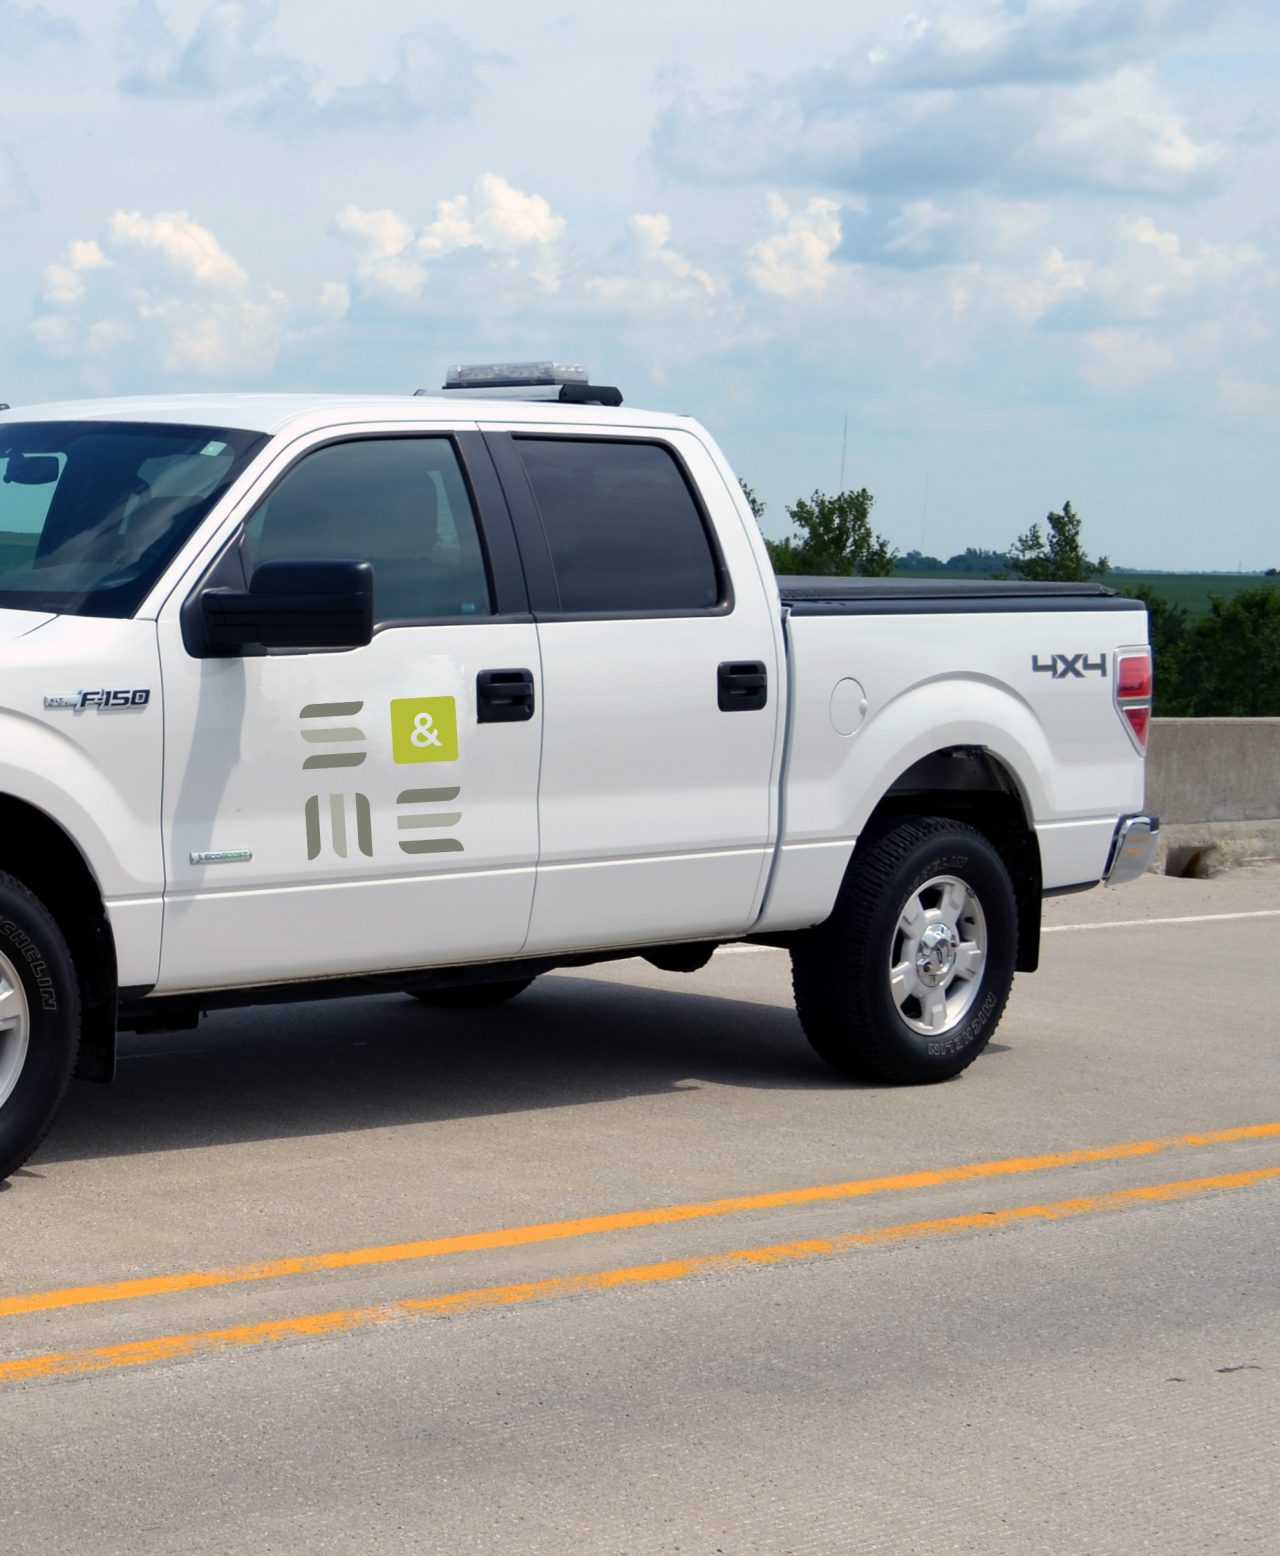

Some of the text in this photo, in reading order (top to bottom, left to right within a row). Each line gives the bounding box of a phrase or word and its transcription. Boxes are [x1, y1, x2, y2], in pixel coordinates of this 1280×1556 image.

[80, 688, 150, 708] F-150
[410, 712, 443, 748] &
[928, 991, 998, 1056] MICHELIN
